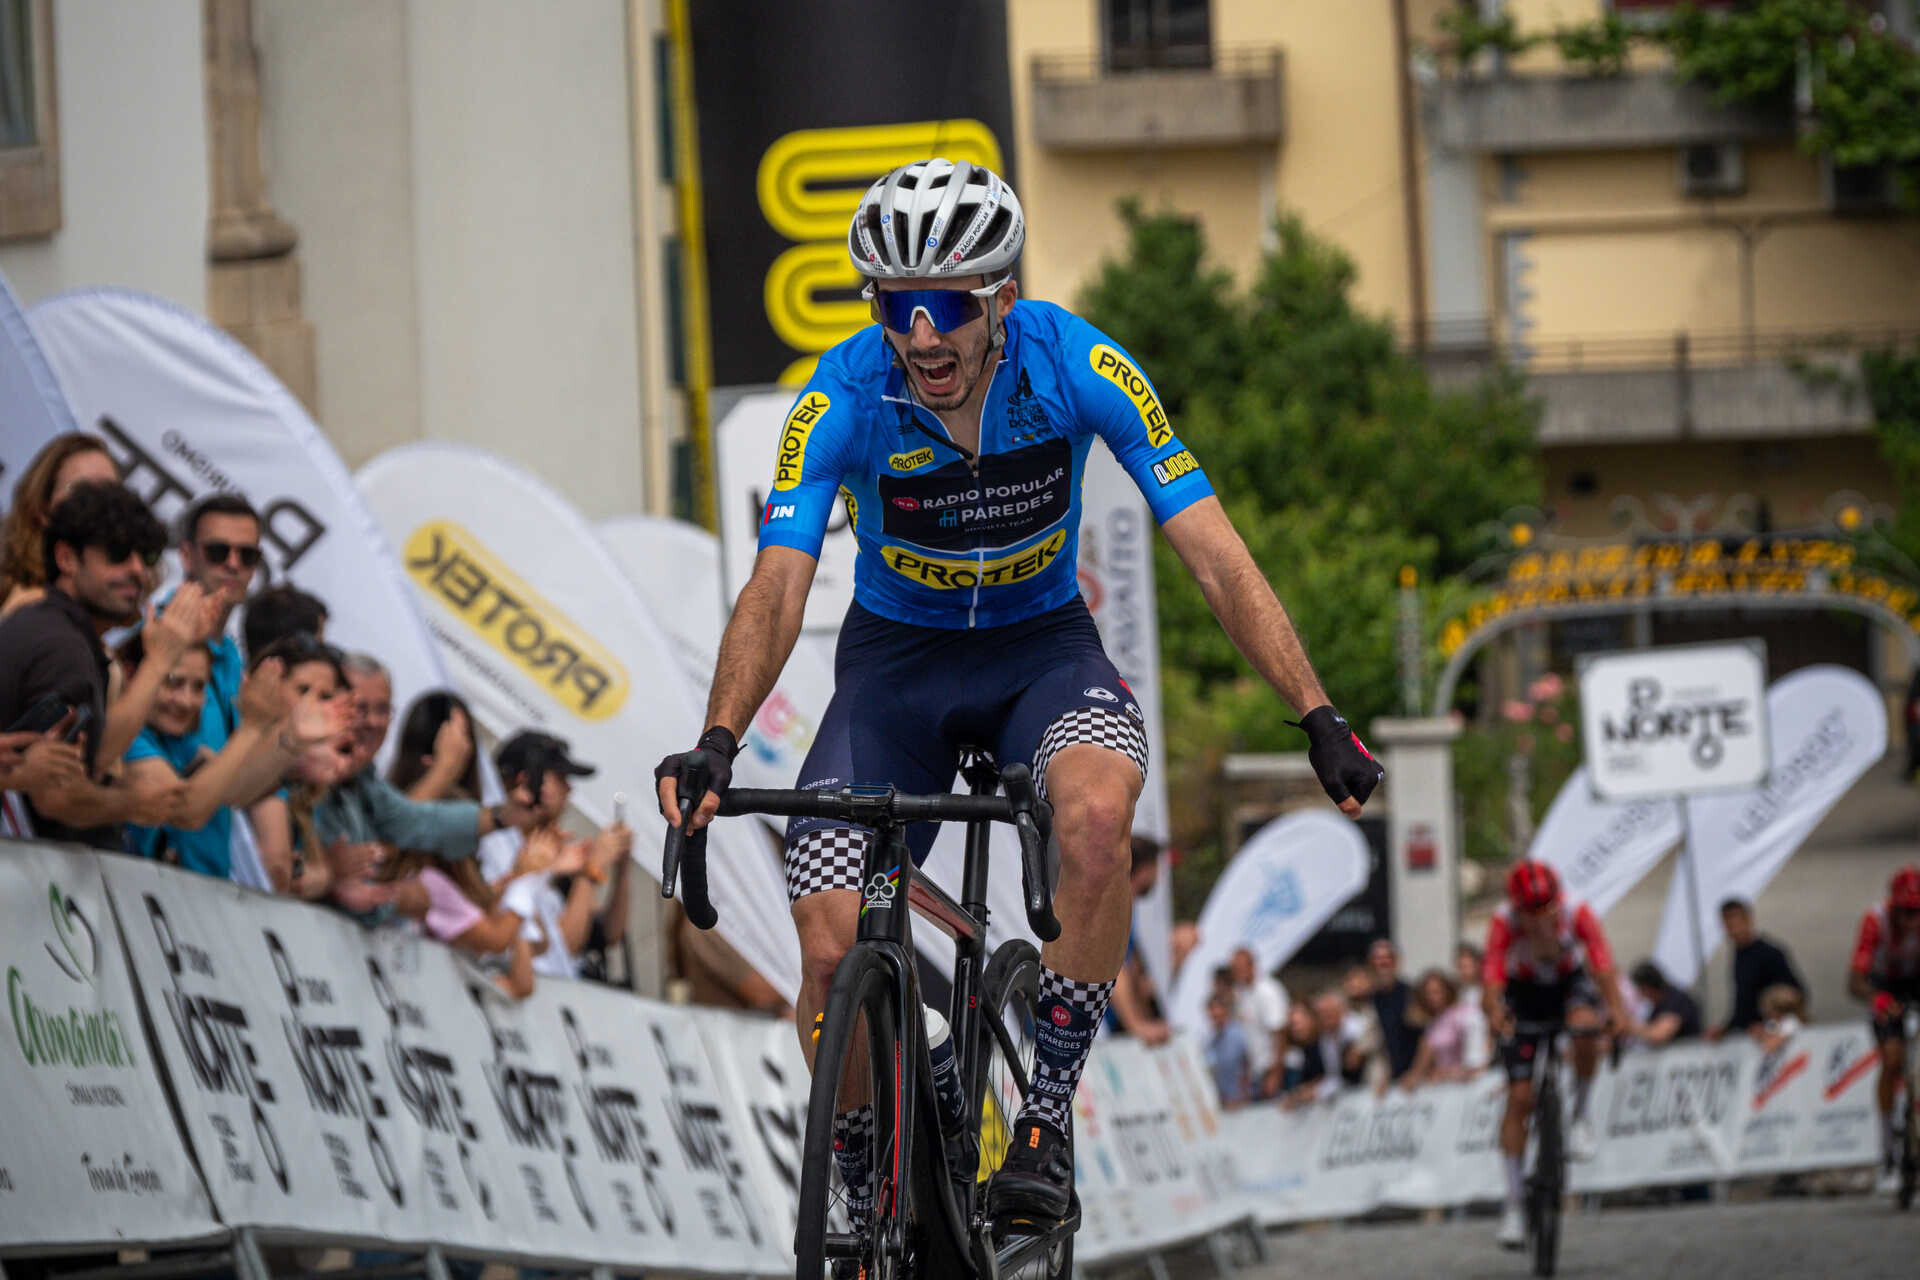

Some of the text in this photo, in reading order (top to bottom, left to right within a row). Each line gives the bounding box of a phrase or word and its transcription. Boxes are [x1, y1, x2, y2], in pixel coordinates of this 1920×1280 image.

[1098, 352, 1169, 447] PROTEK
[778, 396, 829, 482] PROTEK
[892, 449, 932, 470] PROTEK
[923, 467, 1064, 510] RADIO POPULAR
[961, 490, 1054, 523] PAREDES
[894, 535, 1060, 588] PROTEK
[1044, 1033, 1081, 1049] PAREDES
[1054, 1026, 1087, 1038] POPULAR
